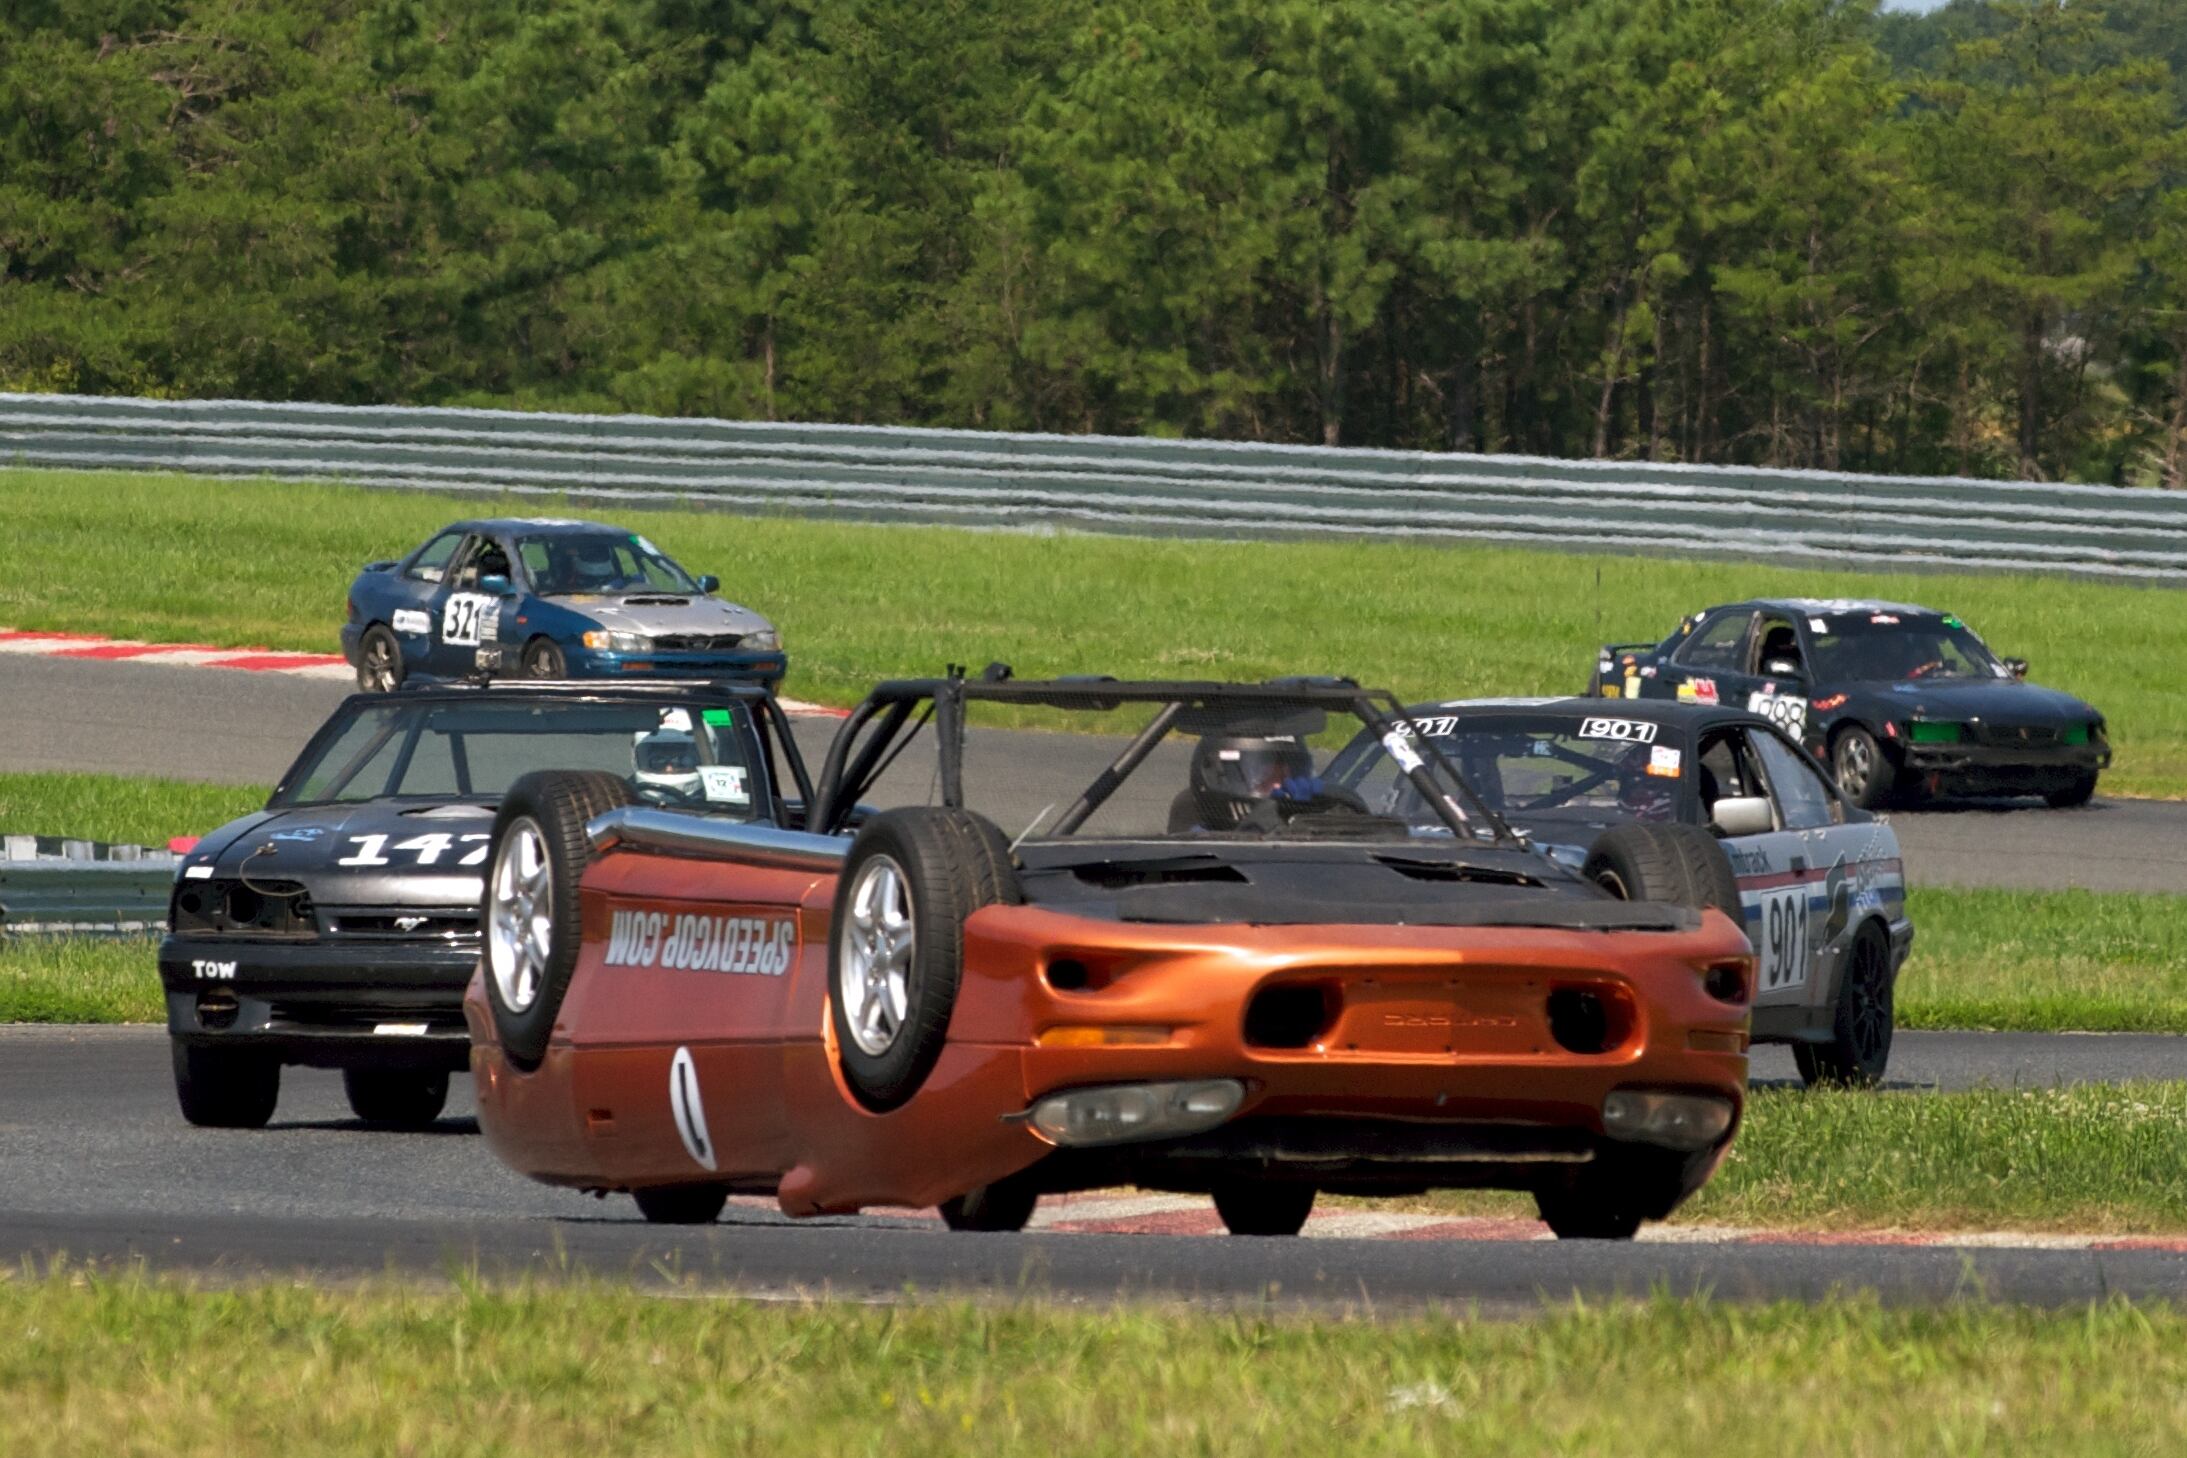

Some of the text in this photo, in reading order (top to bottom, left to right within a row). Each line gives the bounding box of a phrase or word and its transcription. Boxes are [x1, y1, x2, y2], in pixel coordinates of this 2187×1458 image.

[446, 600, 480, 640] 321
[1589, 719, 1649, 741] 901
[604, 910, 795, 977] SPEEDYCOP.COM
[1769, 893, 1806, 987] 901
[192, 960, 237, 979] TOW
